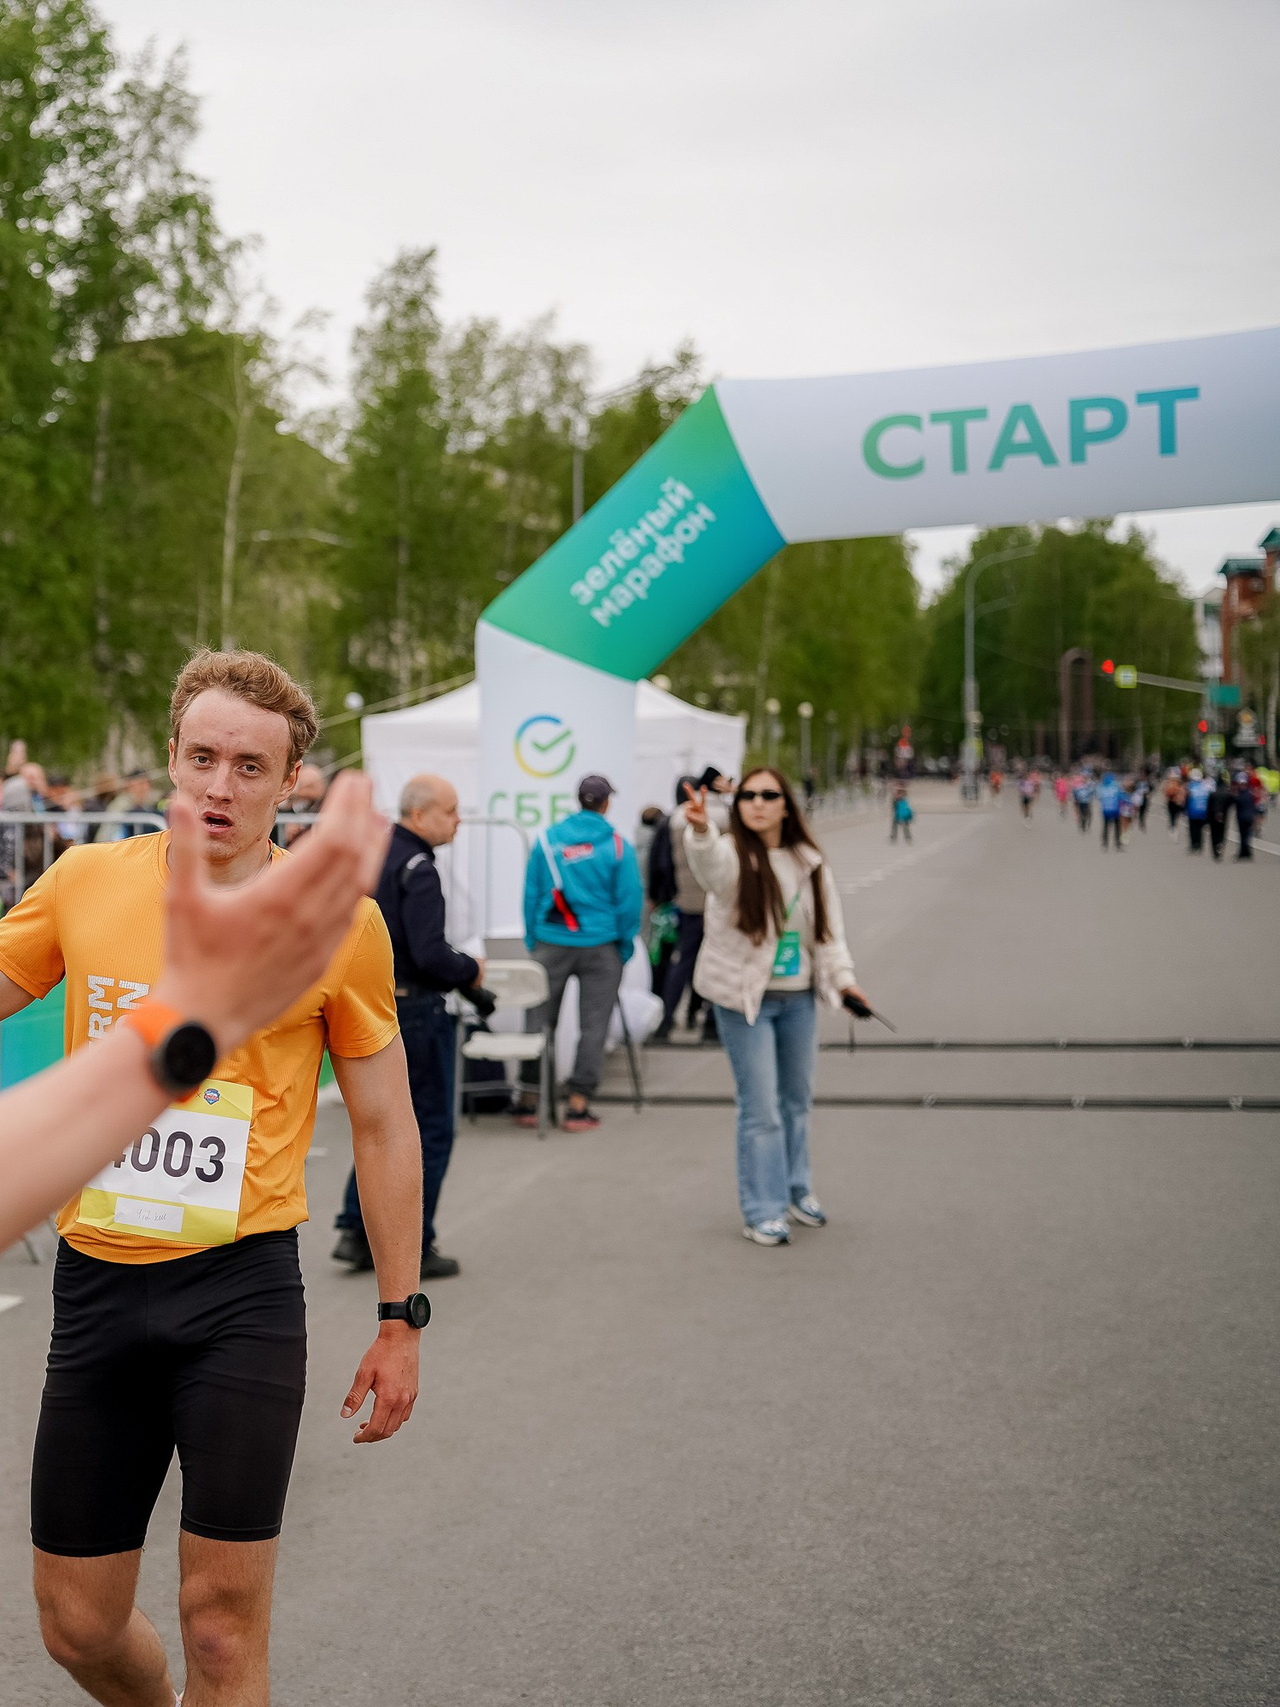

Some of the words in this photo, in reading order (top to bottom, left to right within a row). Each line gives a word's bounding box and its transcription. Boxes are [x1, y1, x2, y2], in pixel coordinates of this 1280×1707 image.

[862, 384, 1200, 480] СТАРТ
[570, 476, 694, 605] зелёный
[590, 501, 717, 628] марафон
[87, 974, 115, 1042] RM
[116, 980, 150, 1010] N
